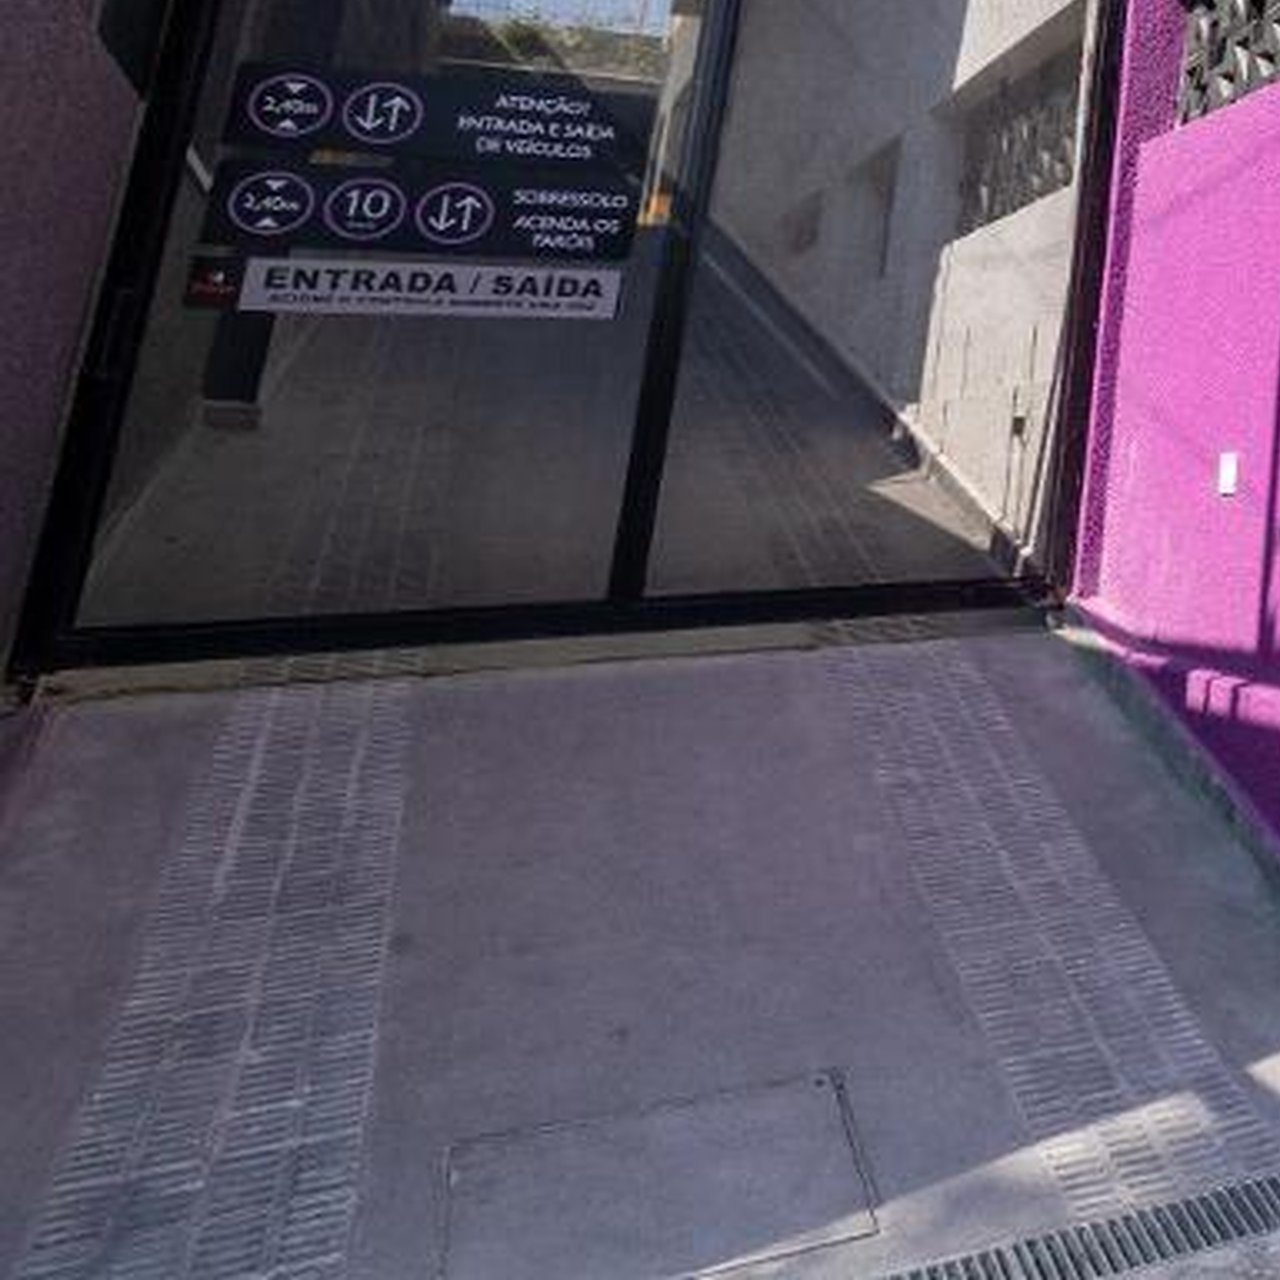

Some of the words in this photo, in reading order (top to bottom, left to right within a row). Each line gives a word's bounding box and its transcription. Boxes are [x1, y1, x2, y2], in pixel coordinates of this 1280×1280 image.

[458, 116, 545, 134] ENTRADA
[346, 189, 391, 218] 10
[264, 267, 457, 295] ENTRADA
